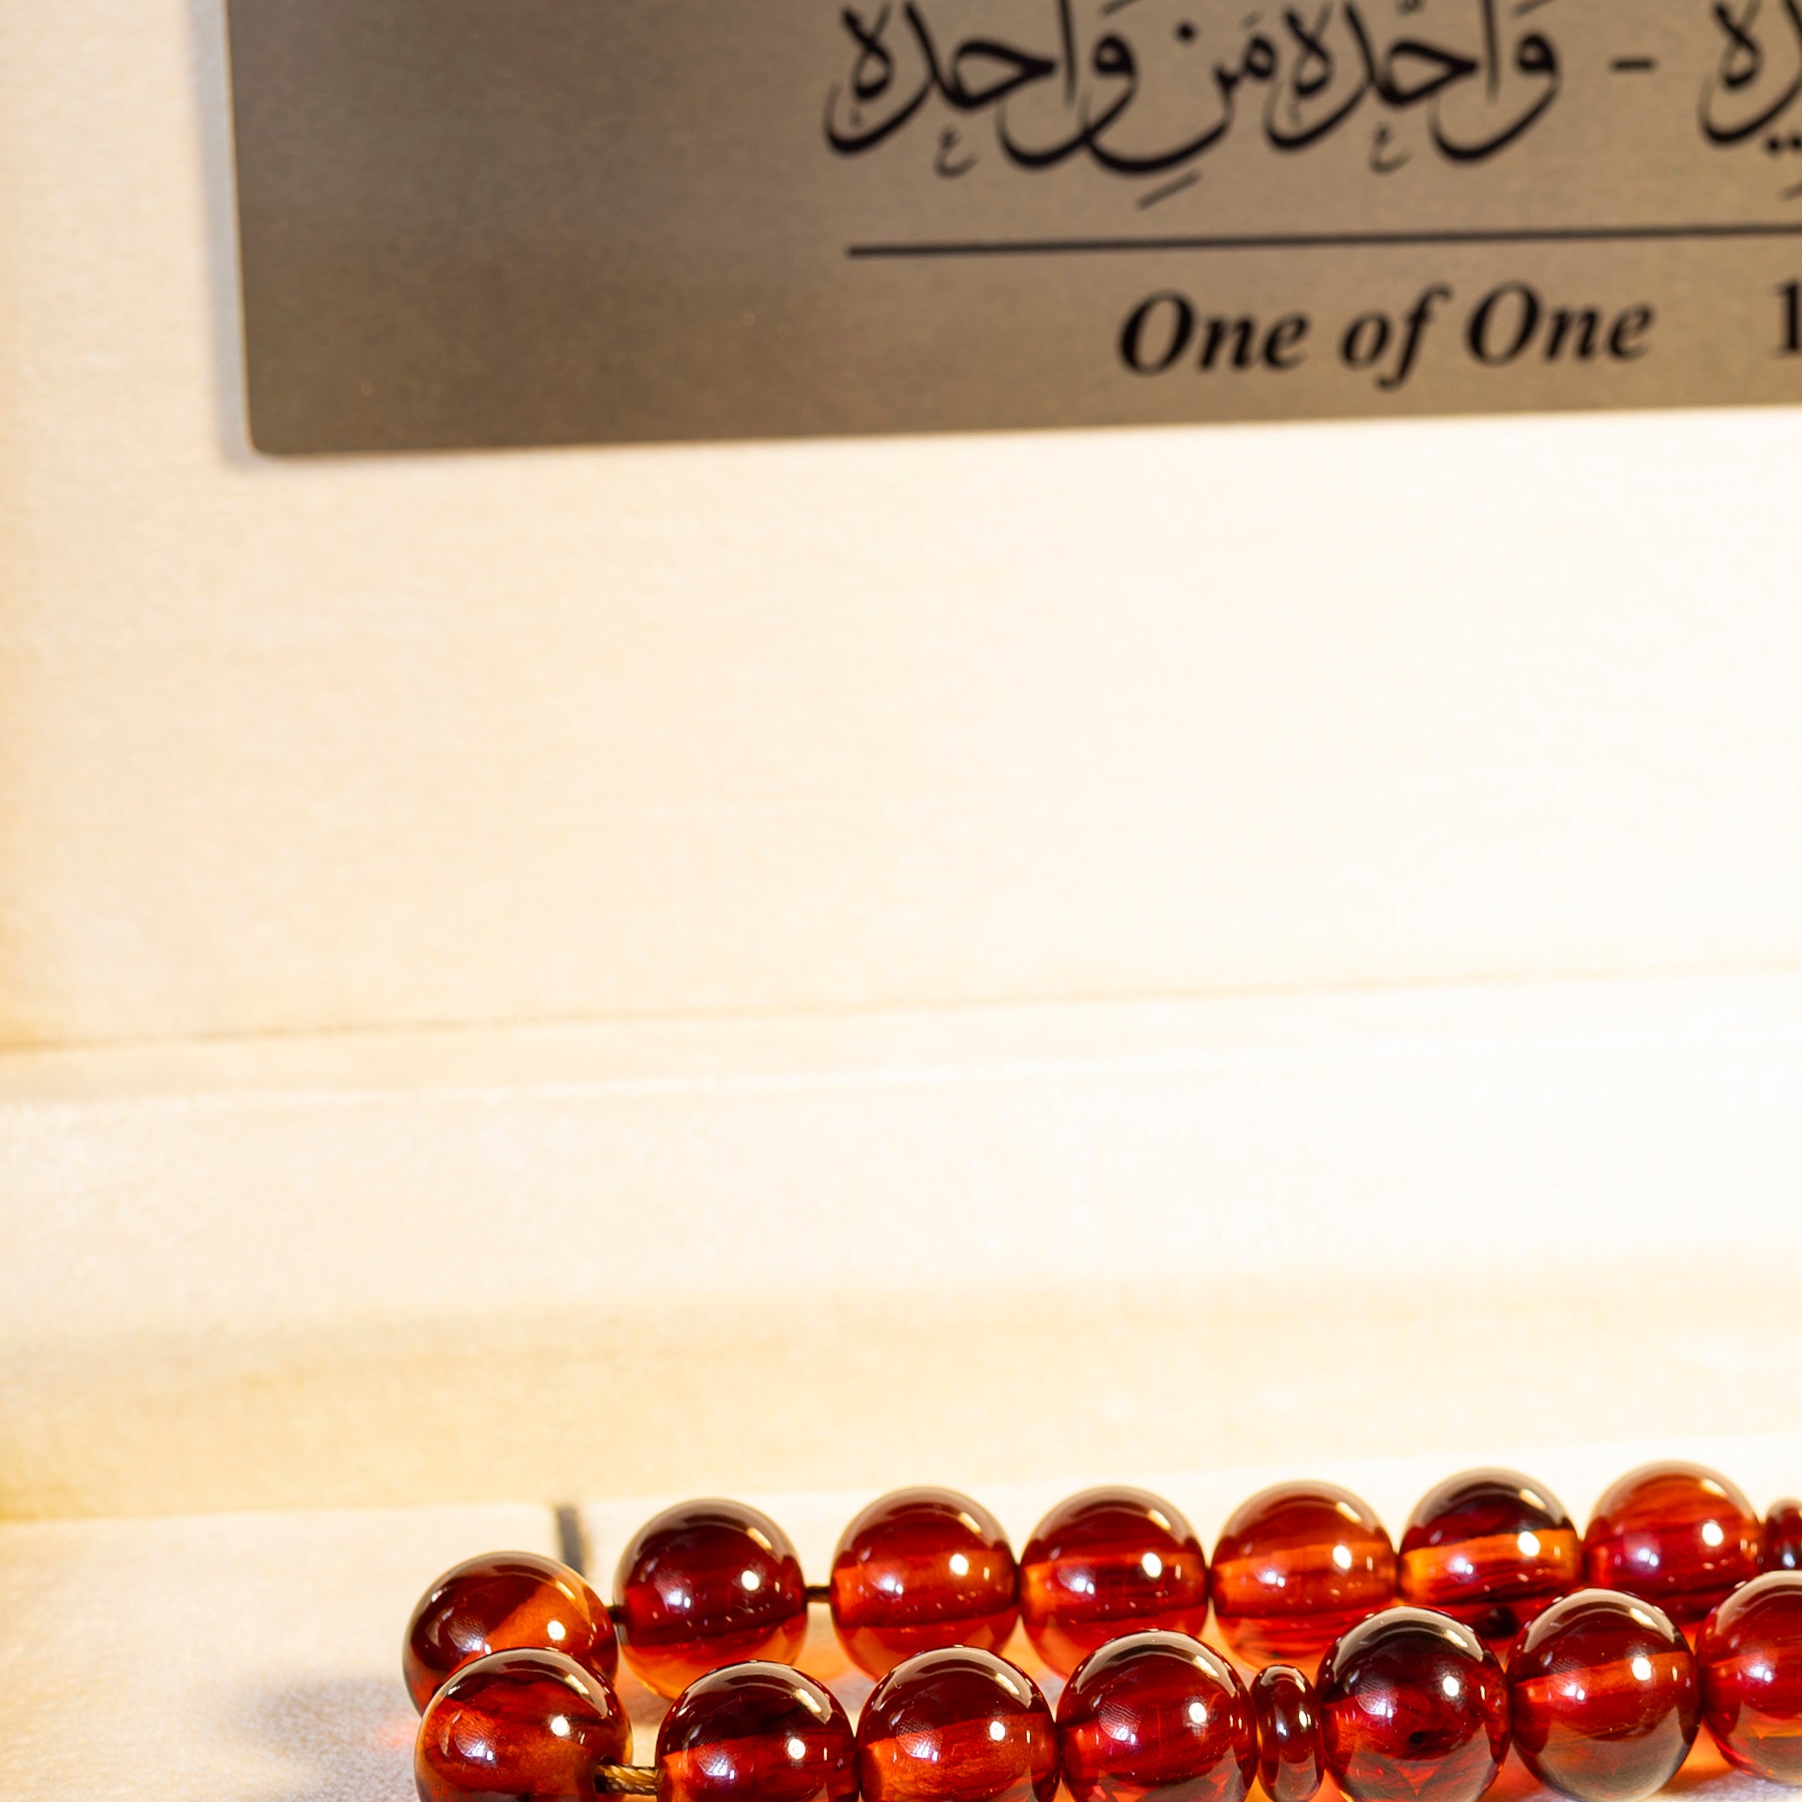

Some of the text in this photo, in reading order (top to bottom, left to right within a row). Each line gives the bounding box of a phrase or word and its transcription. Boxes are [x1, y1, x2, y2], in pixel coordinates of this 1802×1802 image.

[1608, 57, 1657, 73] -
[1116, 289, 1311, 378] One
[1338, 282, 1455, 394] of
[1465, 280, 1656, 369] One
